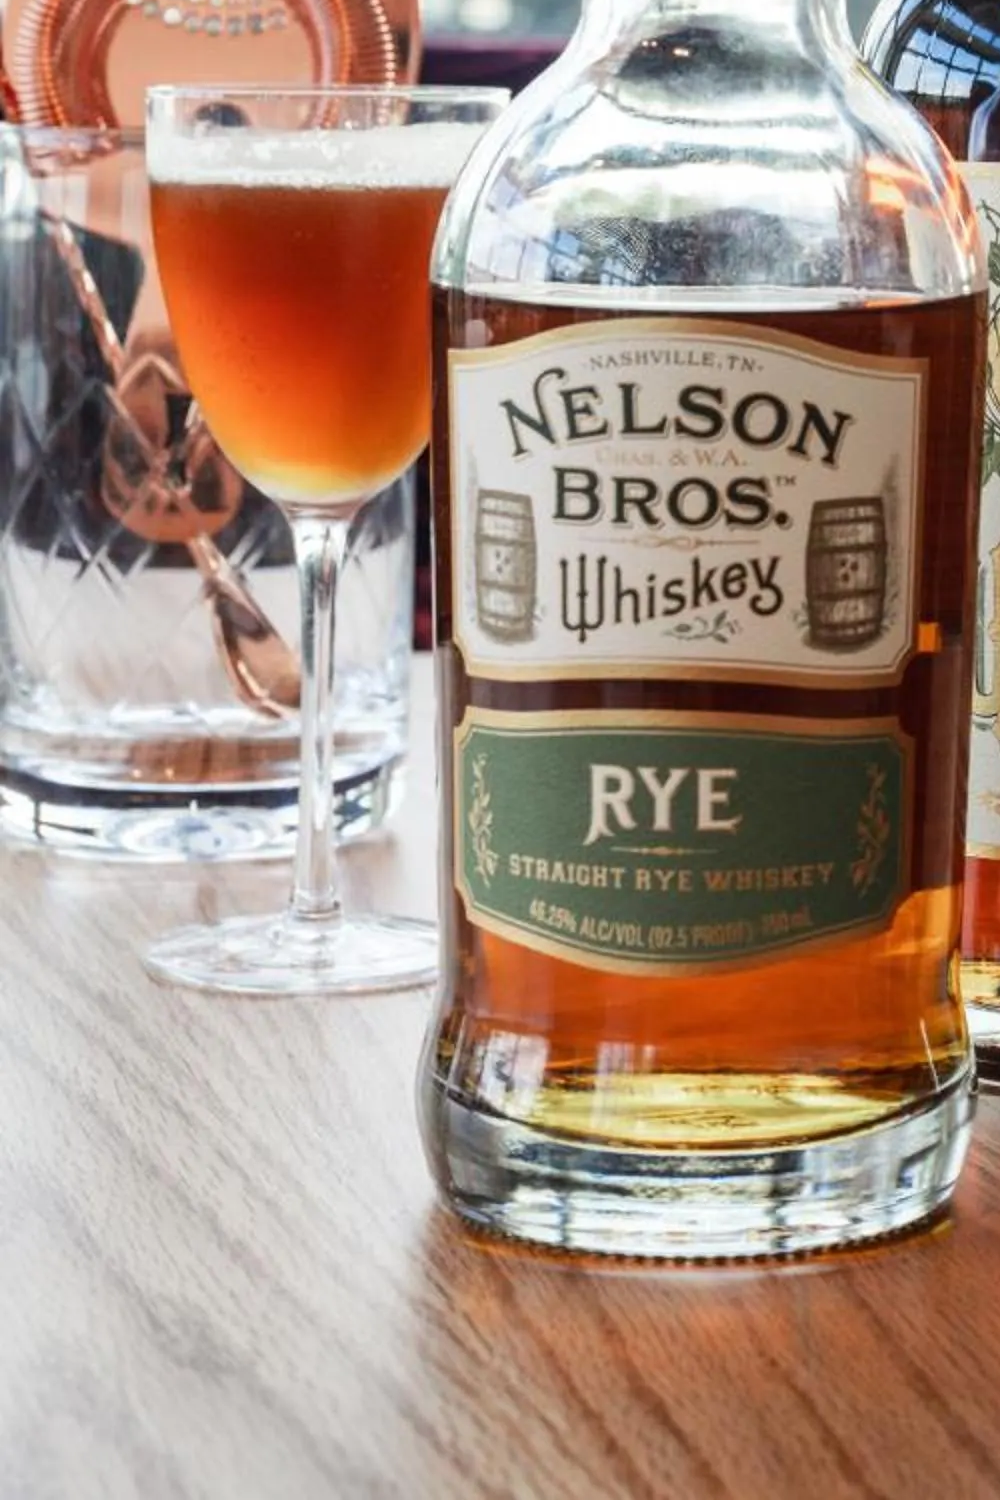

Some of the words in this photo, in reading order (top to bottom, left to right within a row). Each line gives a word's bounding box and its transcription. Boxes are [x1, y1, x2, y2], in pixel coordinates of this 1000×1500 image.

[499, 366, 855, 468] NELSON
[552, 465, 792, 532] BROS.
[558, 552, 786, 645] Whiskey
[582, 763, 744, 846] RYE
[507, 854, 627, 891] STRAIGHT
[634, 867, 694, 892] RYE
[704, 861, 836, 892] WHISKEY
